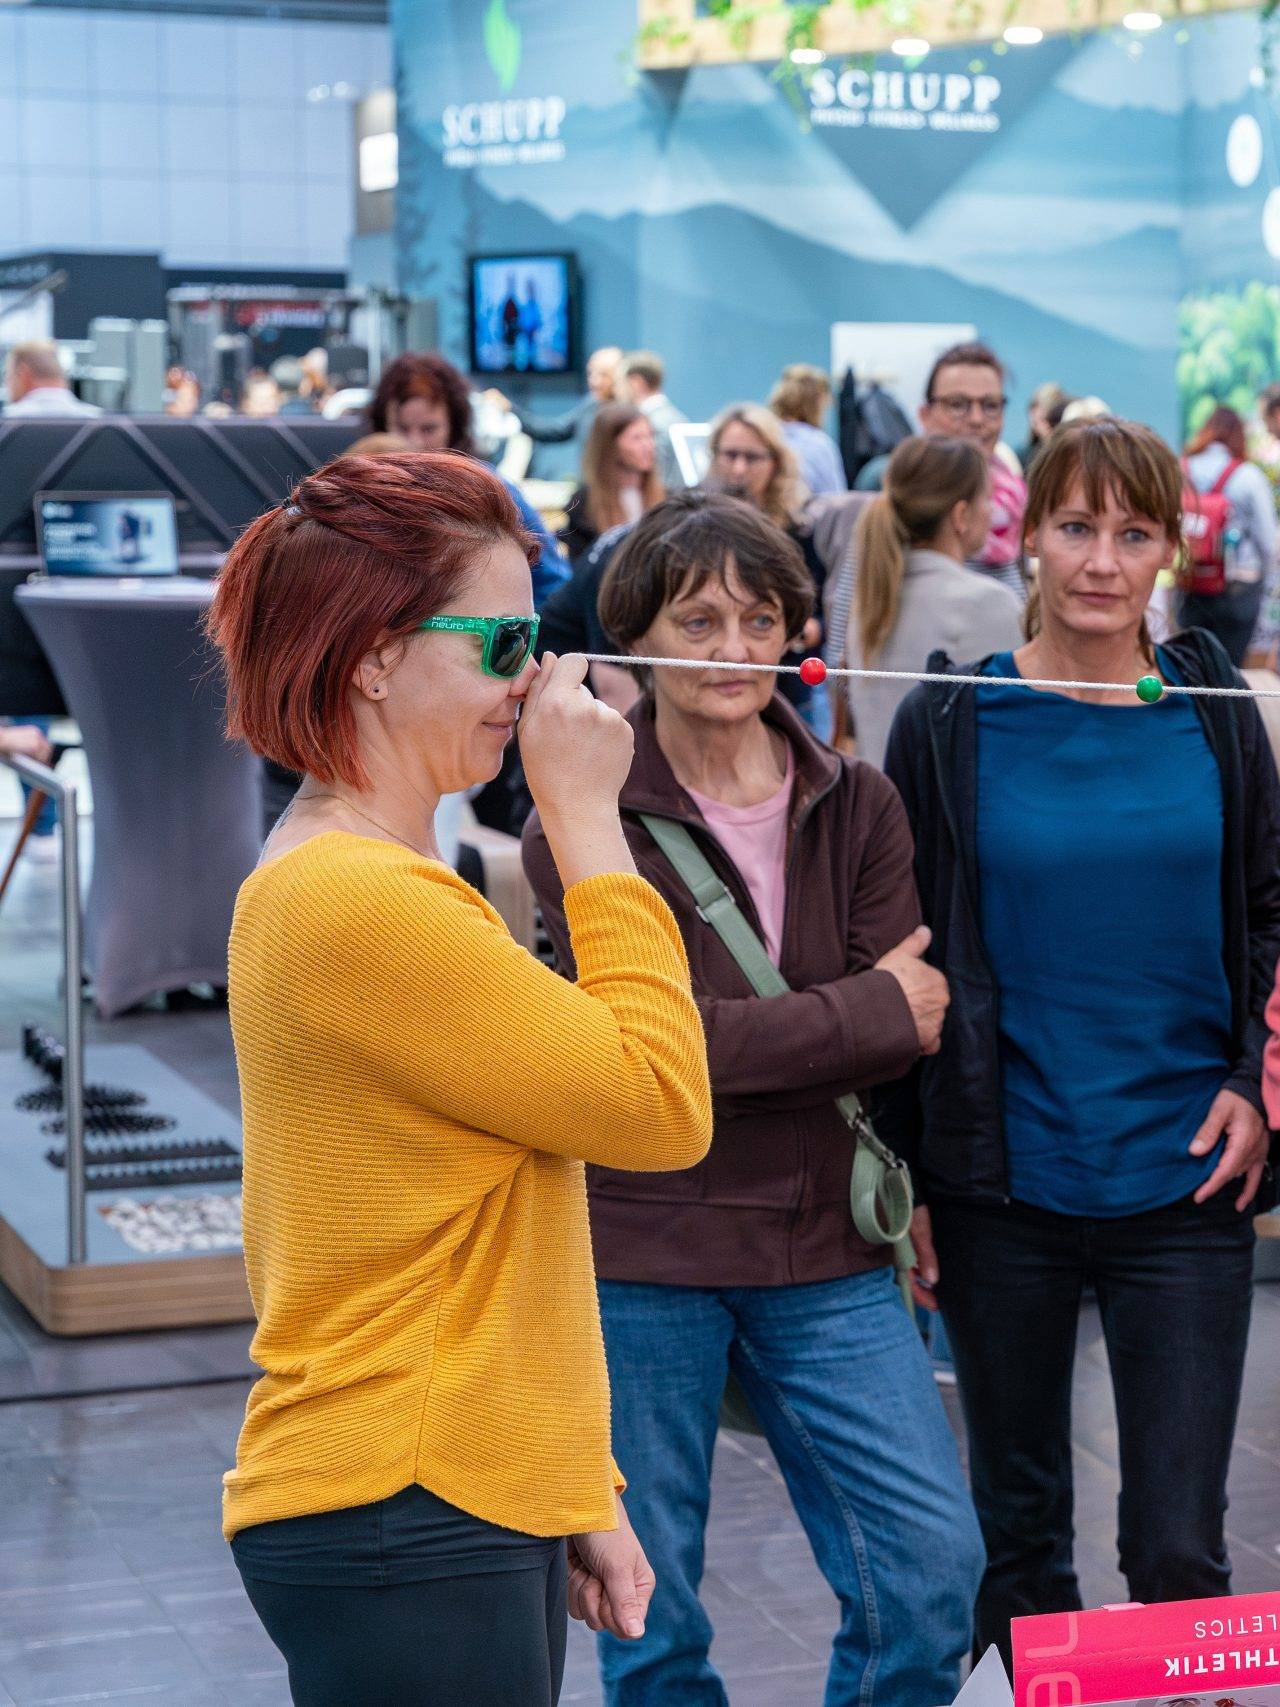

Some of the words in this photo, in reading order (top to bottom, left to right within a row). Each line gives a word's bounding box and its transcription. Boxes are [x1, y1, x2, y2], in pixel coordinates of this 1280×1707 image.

[810, 67, 1001, 112] SCHUPP
[442, 96, 567, 147] SCHUPP
[431, 621, 464, 630] neuro
